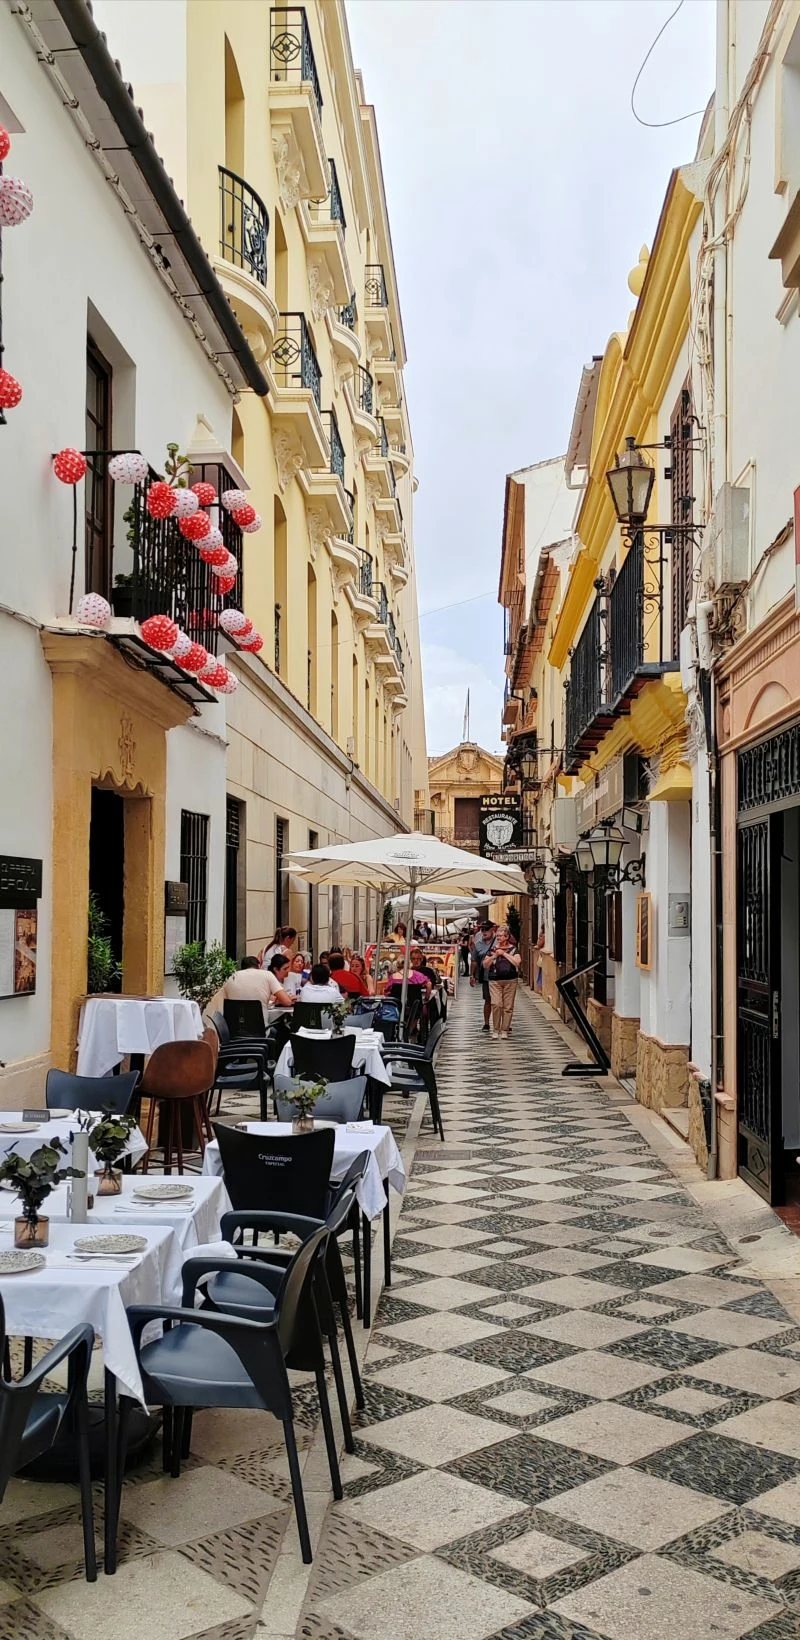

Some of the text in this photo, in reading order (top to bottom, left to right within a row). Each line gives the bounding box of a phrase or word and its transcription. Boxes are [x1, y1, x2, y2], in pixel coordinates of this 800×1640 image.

[482, 797, 518, 805] HOTEL
[482, 813, 518, 825] RESTAURANTE
[258, 1153, 293, 1162] Cruzcampo
